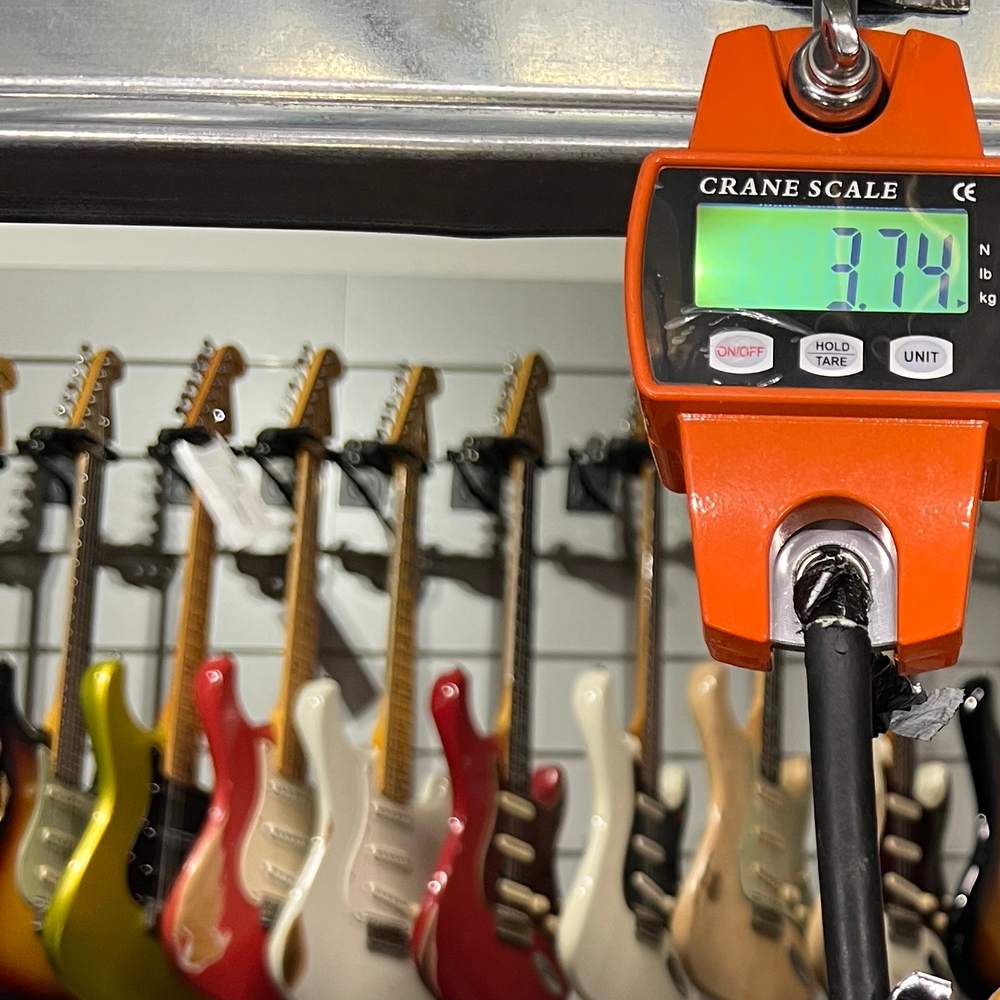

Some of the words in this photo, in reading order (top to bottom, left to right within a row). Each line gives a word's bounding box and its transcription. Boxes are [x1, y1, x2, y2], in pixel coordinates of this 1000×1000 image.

[700, 177, 799, 197] CRANE
[808, 180, 898, 200] SCALE
[980, 243, 990, 256] N
[826, 227, 954, 310] 3.74
[979, 267, 992, 280] lb
[979, 291, 997, 307] kg
[717, 345, 765, 357] ON/OFF
[816, 341, 850, 352] HOLD
[816, 356, 848, 367] TARE
[904, 350, 939, 363] UNIT
